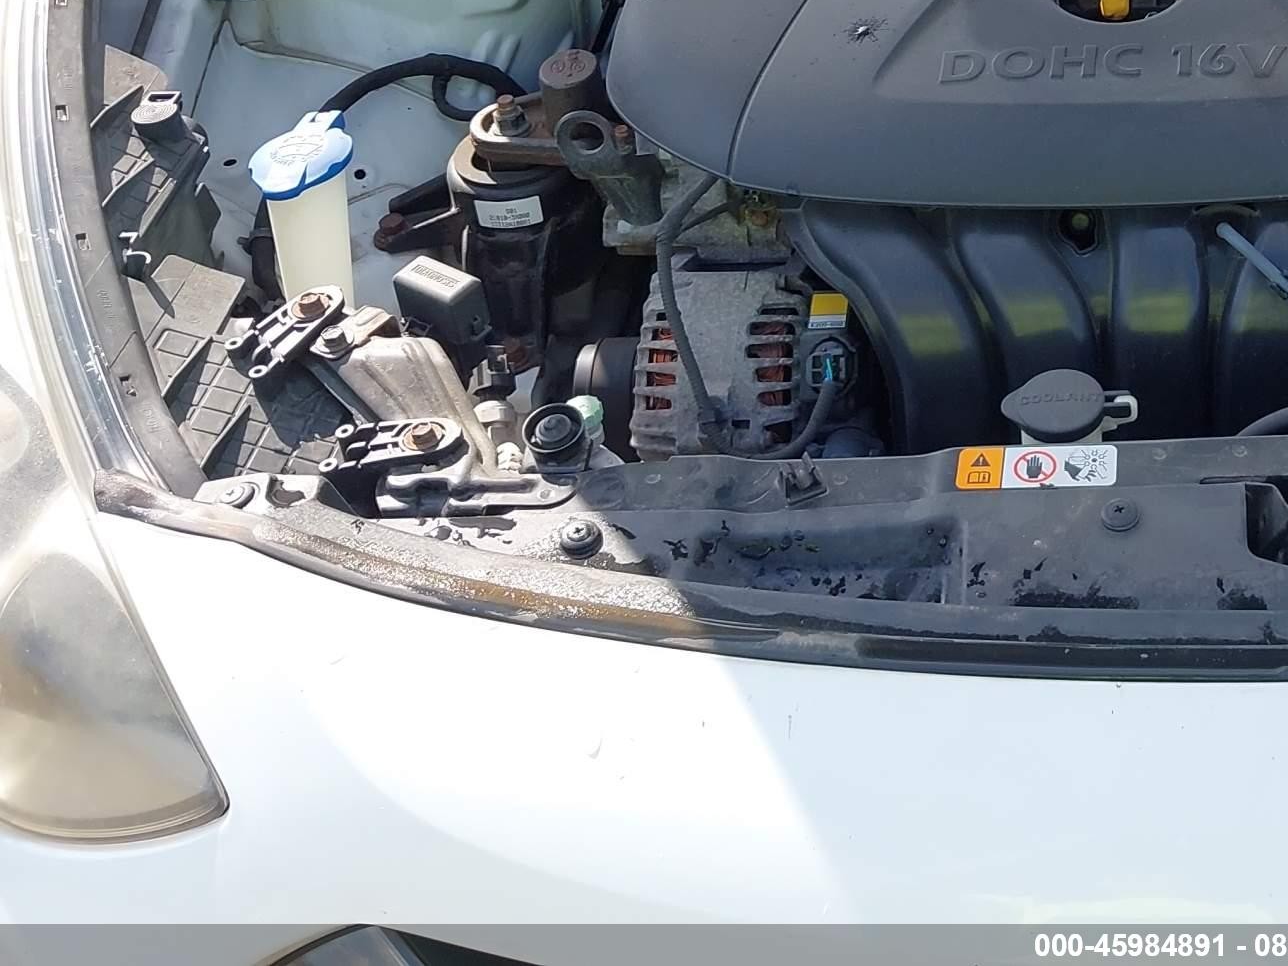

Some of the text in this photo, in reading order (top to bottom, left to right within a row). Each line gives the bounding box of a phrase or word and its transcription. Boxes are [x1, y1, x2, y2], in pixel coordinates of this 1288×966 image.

[939, 42, 1288, 84] DOHC 16V
[1020, 393, 1099, 406] COOLANT
